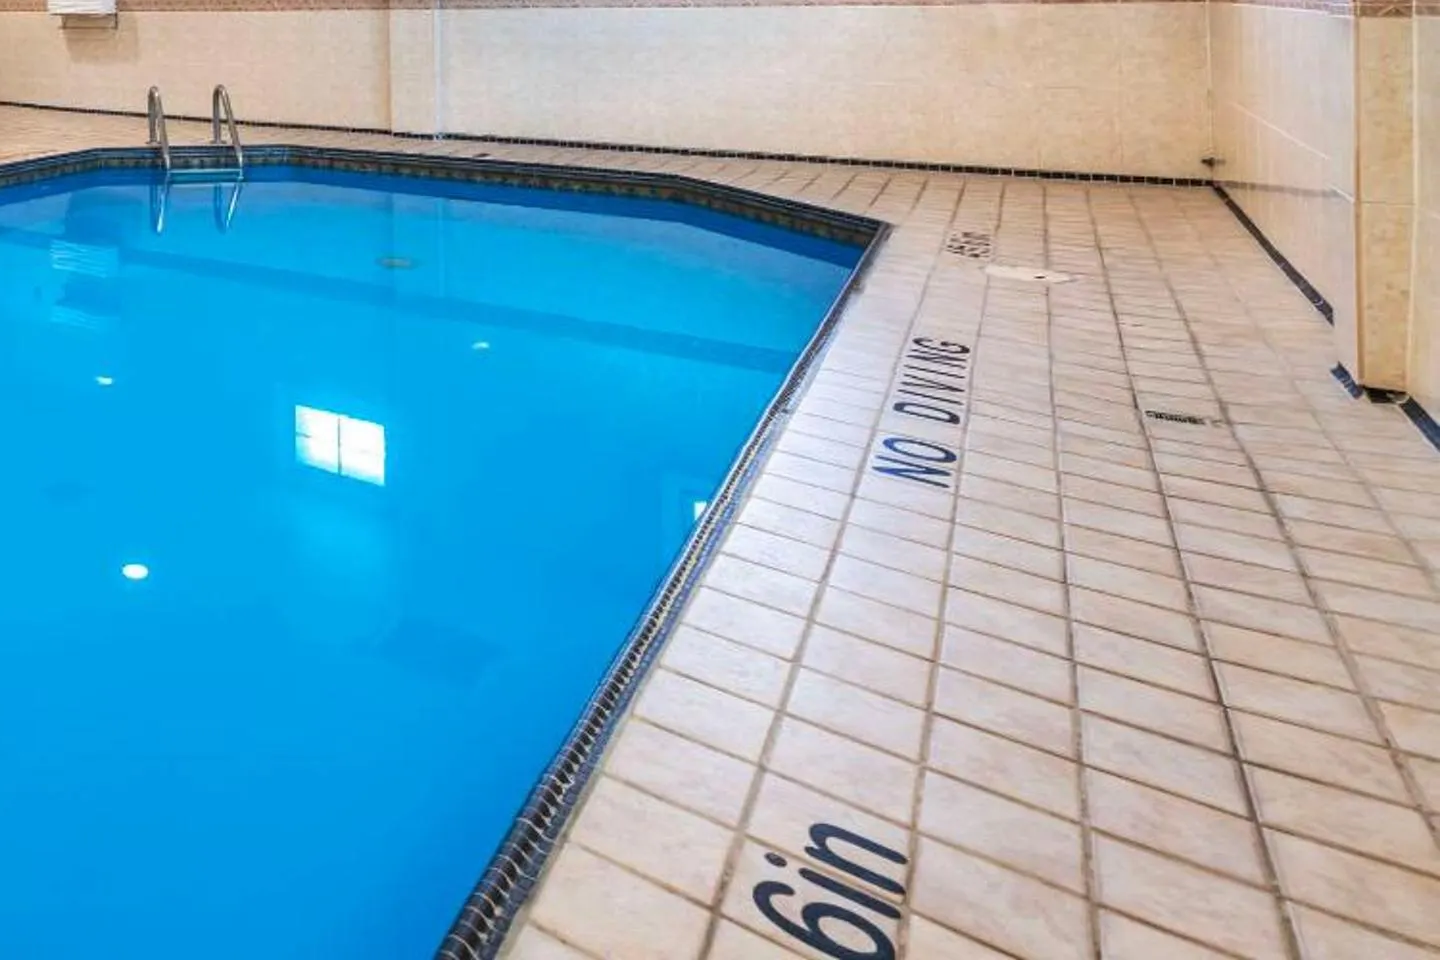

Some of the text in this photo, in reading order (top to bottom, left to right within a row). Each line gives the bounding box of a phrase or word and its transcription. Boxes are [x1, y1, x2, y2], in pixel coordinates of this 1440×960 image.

[892, 337, 971, 426] DIVING
[872, 436, 957, 489] NO
[752, 822, 909, 960] 6in
